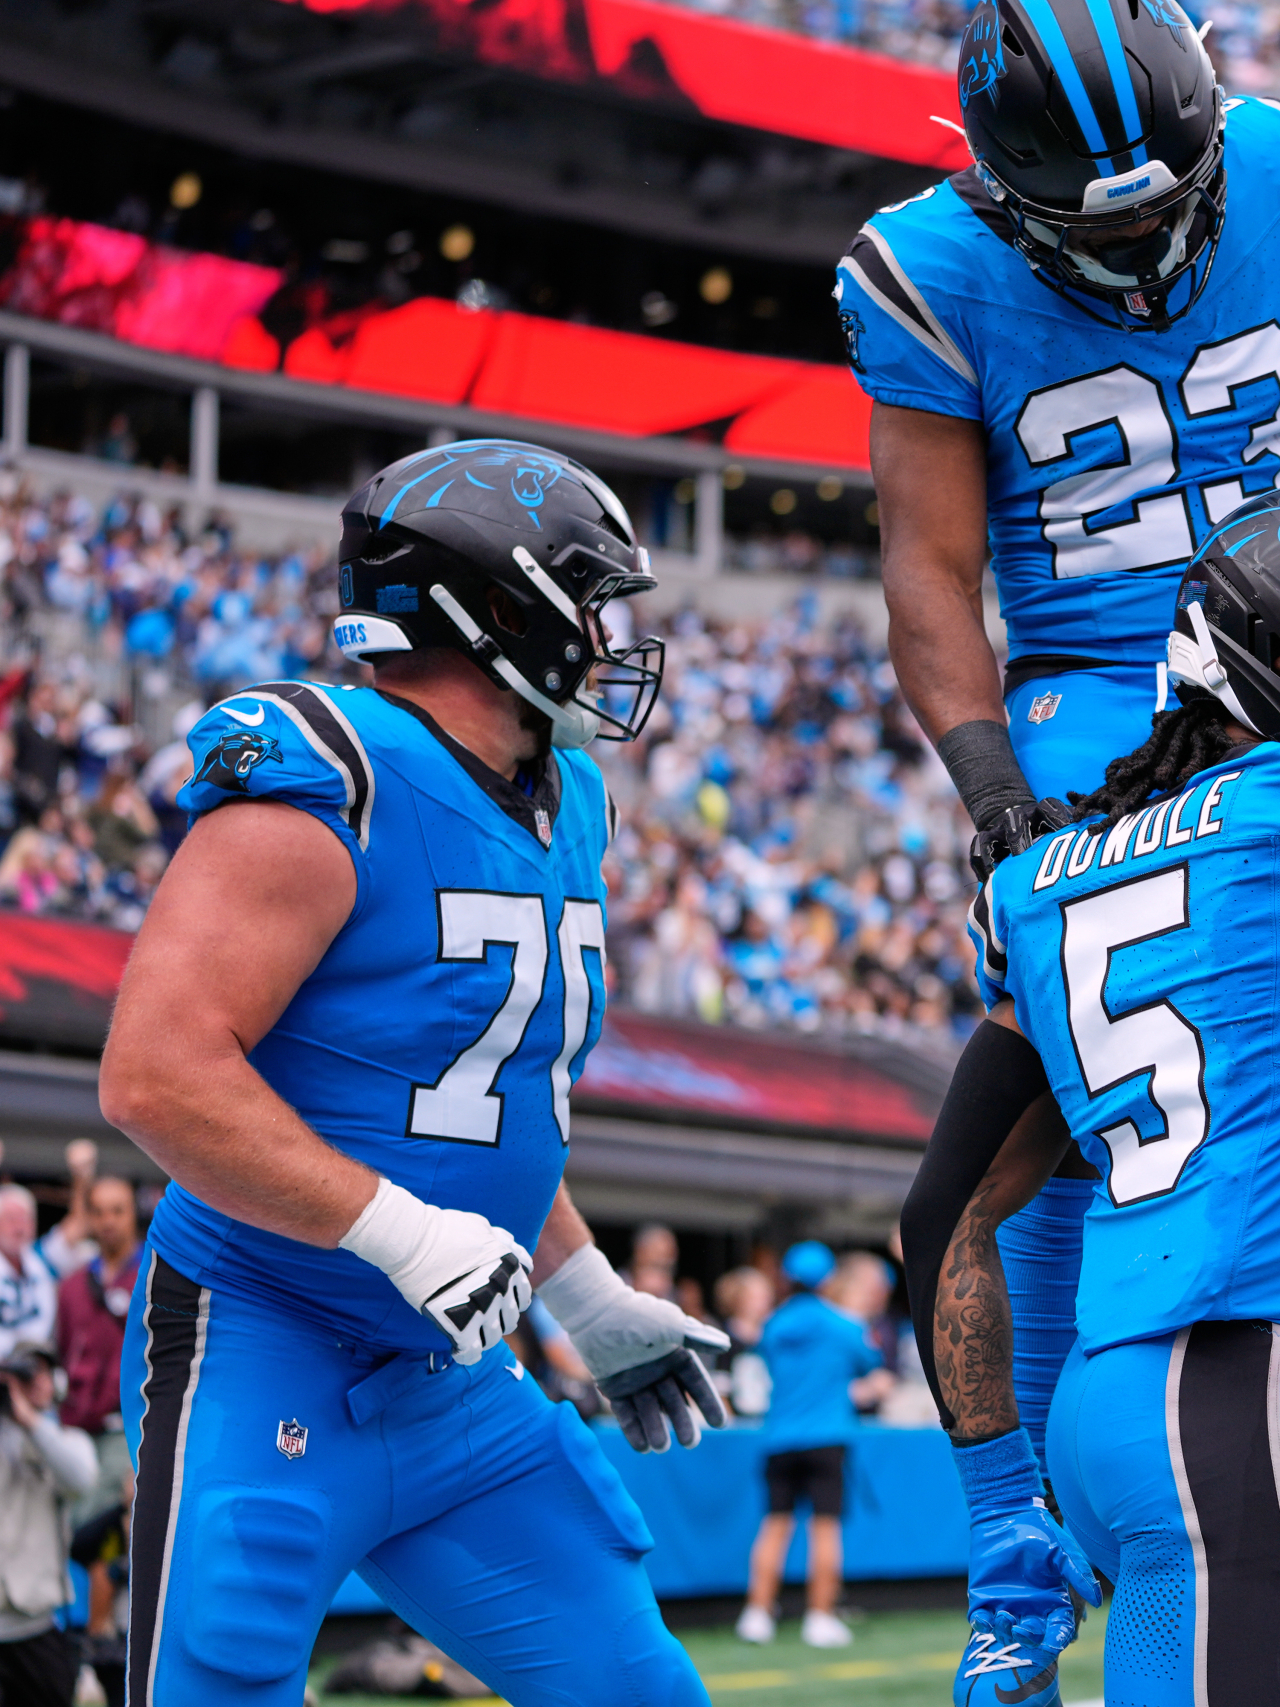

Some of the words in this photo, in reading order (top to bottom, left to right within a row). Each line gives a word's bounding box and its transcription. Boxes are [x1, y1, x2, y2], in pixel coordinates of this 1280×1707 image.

[1031, 768, 1245, 895] DOWDLE
[405, 887, 606, 1148] 70
[1058, 860, 1212, 1209] 5
